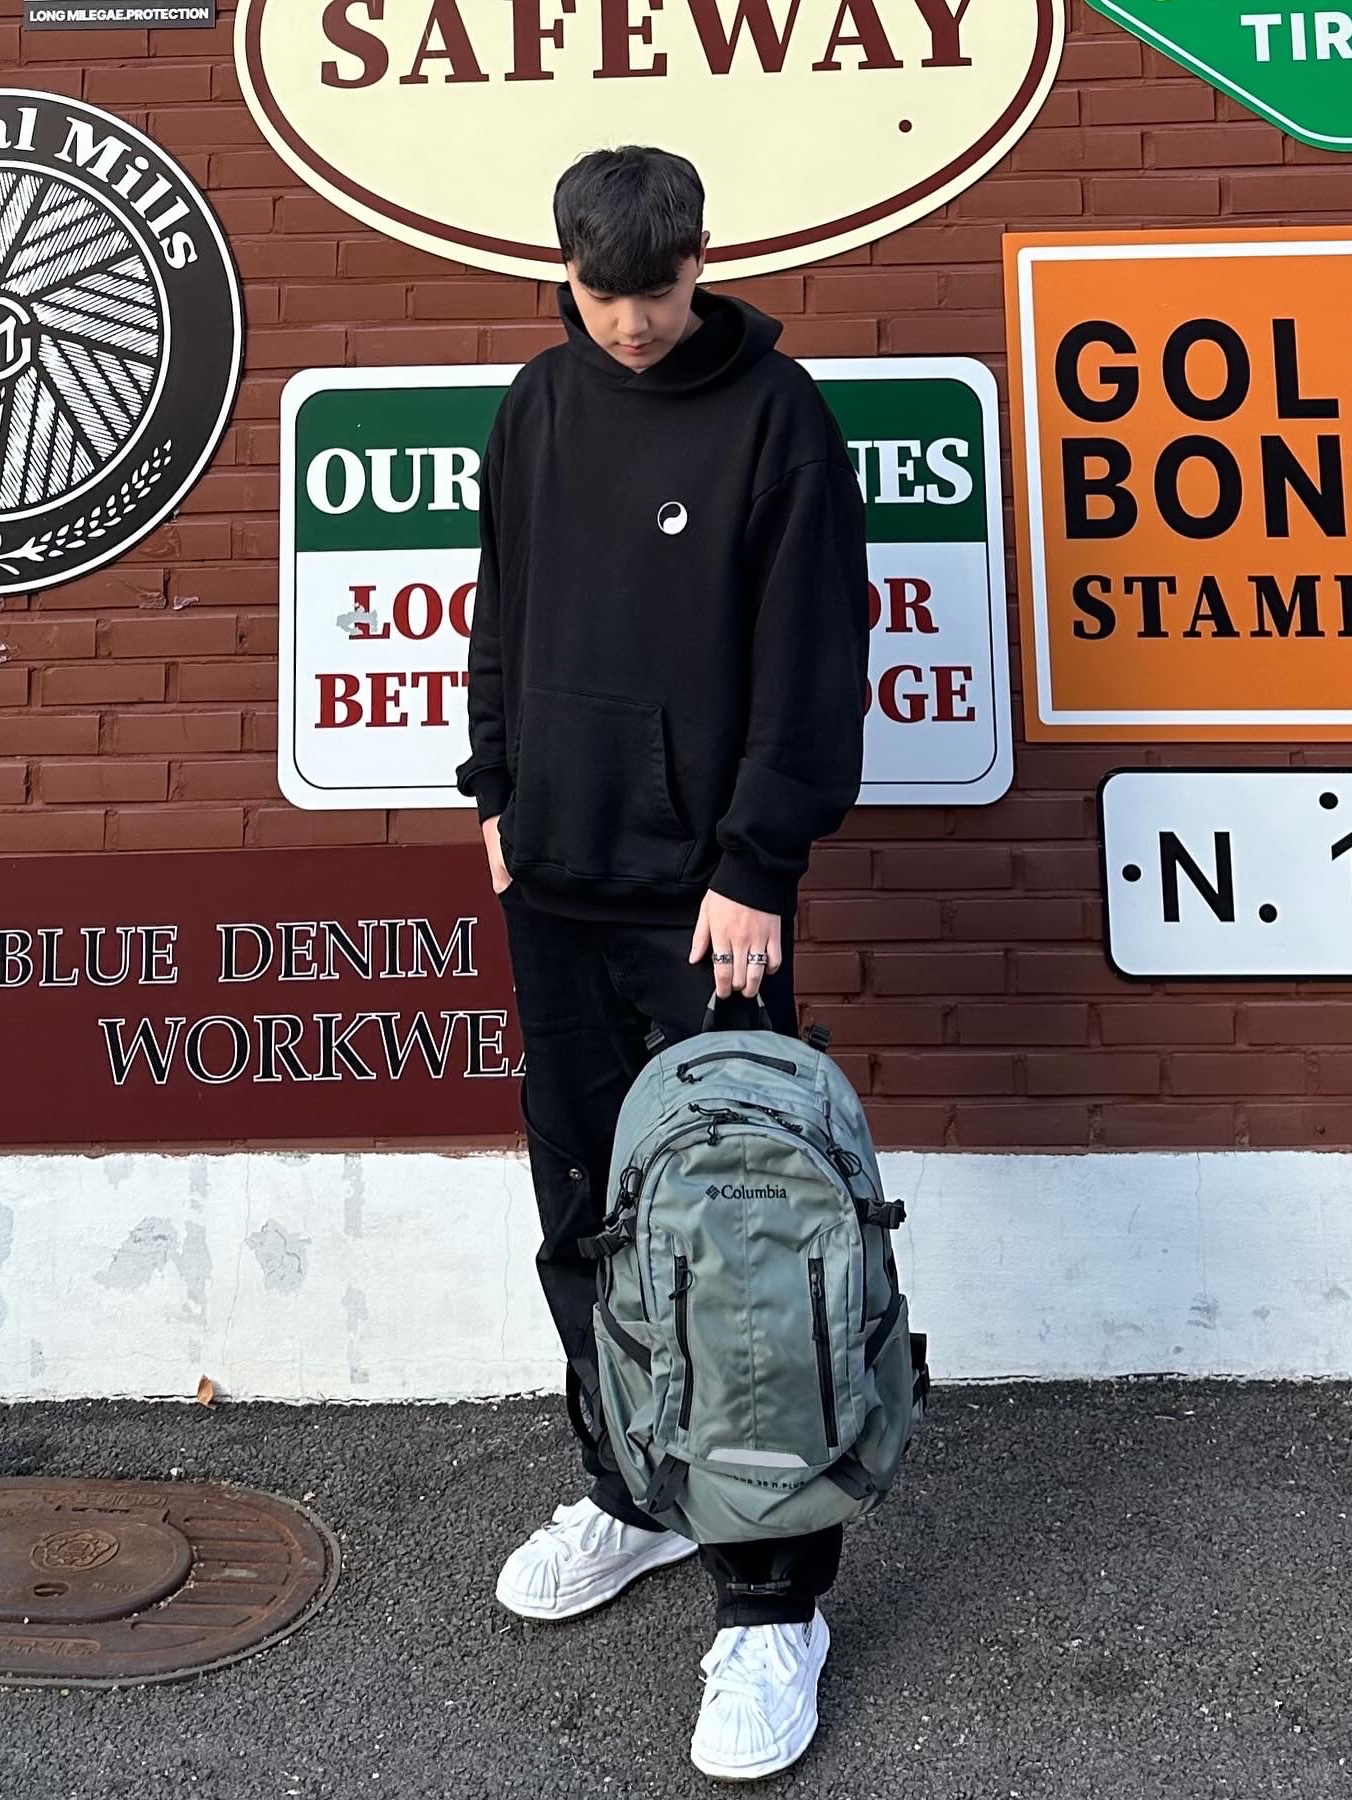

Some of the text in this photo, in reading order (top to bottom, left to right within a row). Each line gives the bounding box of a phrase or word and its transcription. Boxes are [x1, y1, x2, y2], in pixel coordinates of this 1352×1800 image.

[29, 10, 66, 22] LONG
[321, 0, 973, 89] SAFEWAY
[1240, 11, 1352, 62] TIR
[54, 116, 198, 269] Mills
[1055, 318, 1339, 423] GOL
[306, 447, 480, 515] OUR
[1061, 434, 1347, 540] BON
[868, 578, 939, 634] R
[315, 664, 976, 729] BET GE
[1159, 832, 1278, 923] N.
[0, 917, 478, 988] BLUE DENIM
[99, 1009, 526, 1085] WORKWE
[721, 1184, 787, 1200] Columbia
